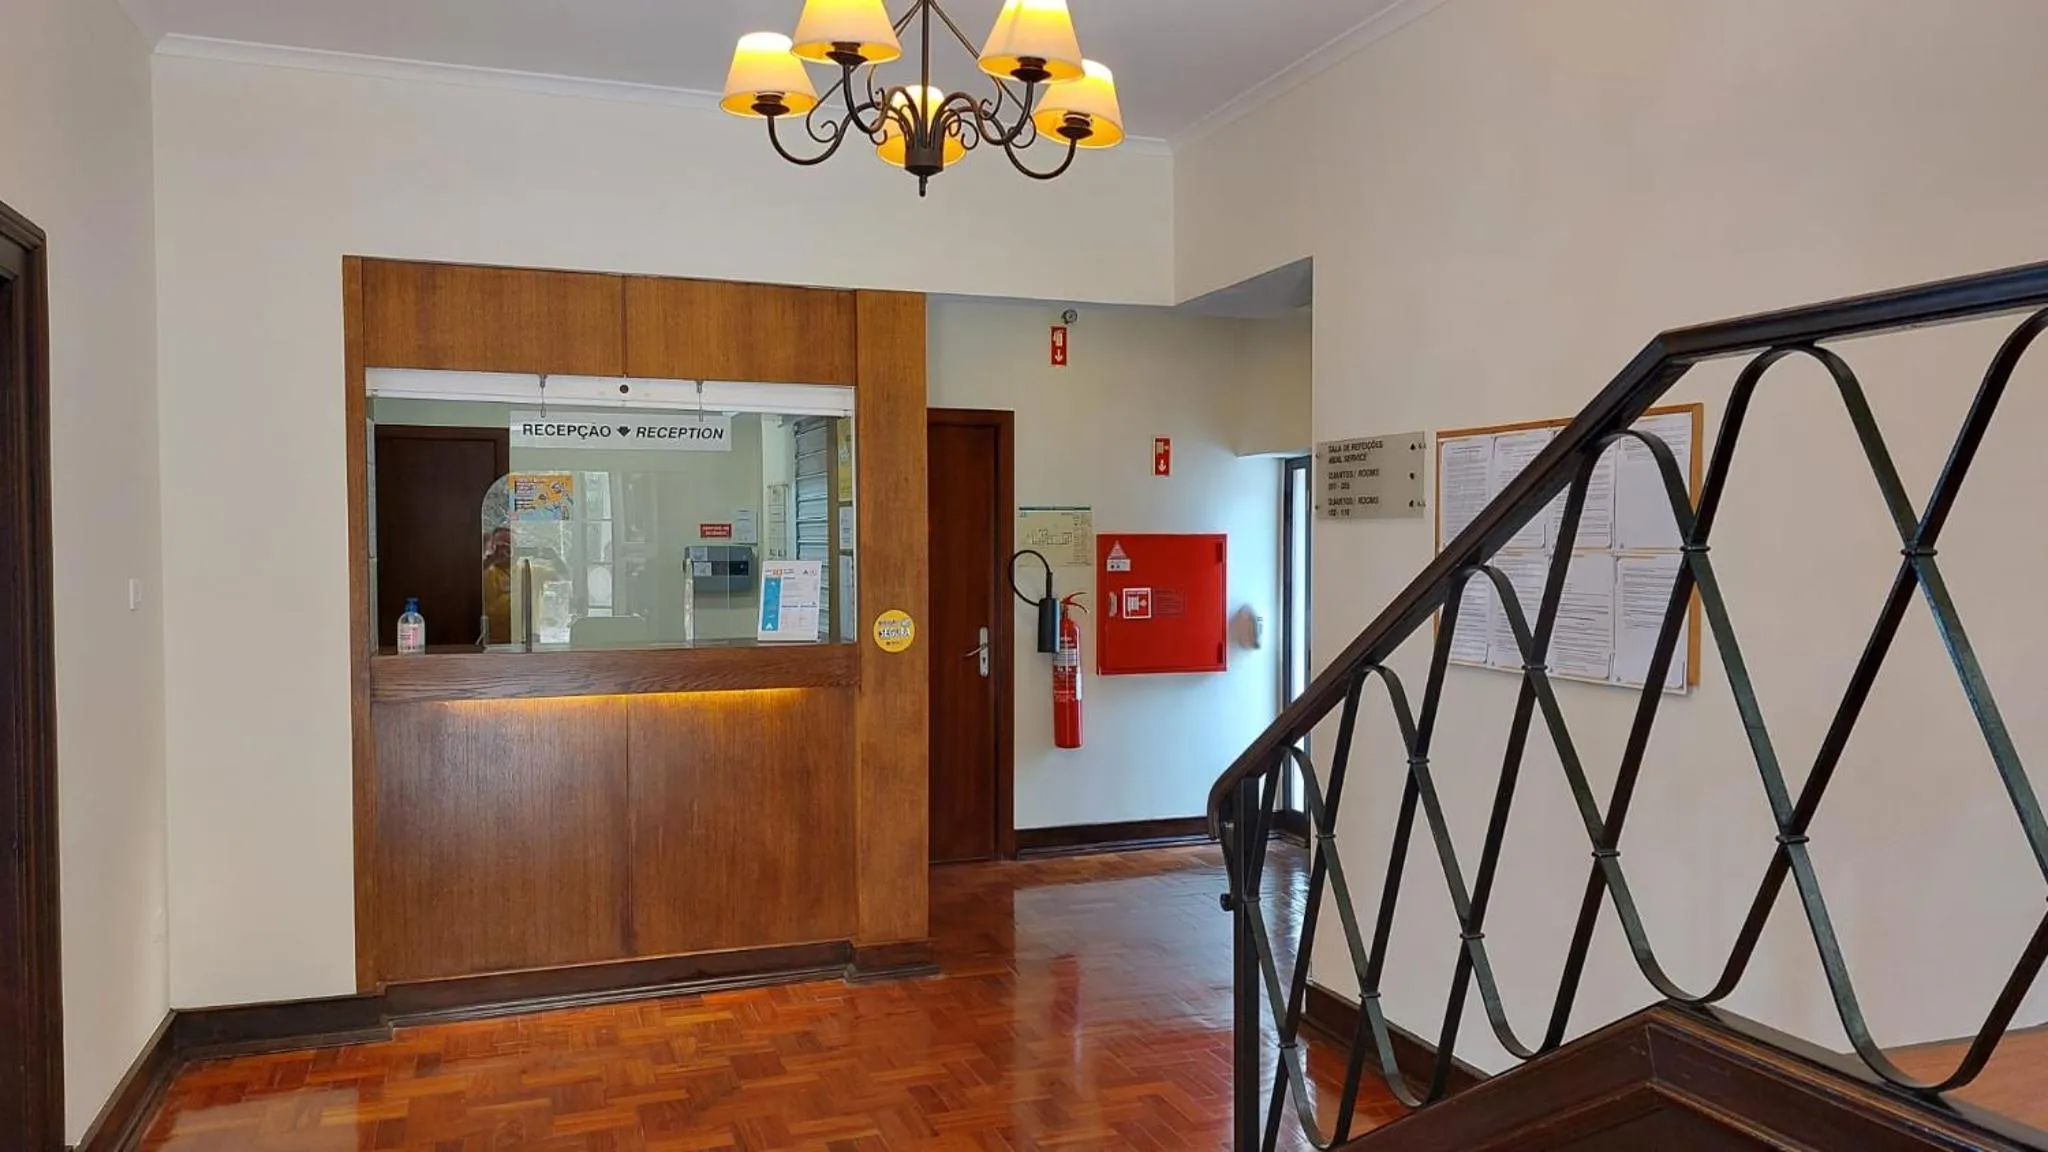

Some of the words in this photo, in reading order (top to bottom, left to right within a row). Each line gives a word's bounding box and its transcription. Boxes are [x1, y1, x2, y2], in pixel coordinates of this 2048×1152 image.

[636, 426, 725, 439] RECEPTION
[1343, 452, 1367, 462] SERVICE
[1357, 468, 1380, 477] ROOMS
[1357, 496, 1379, 504] ROOMS
